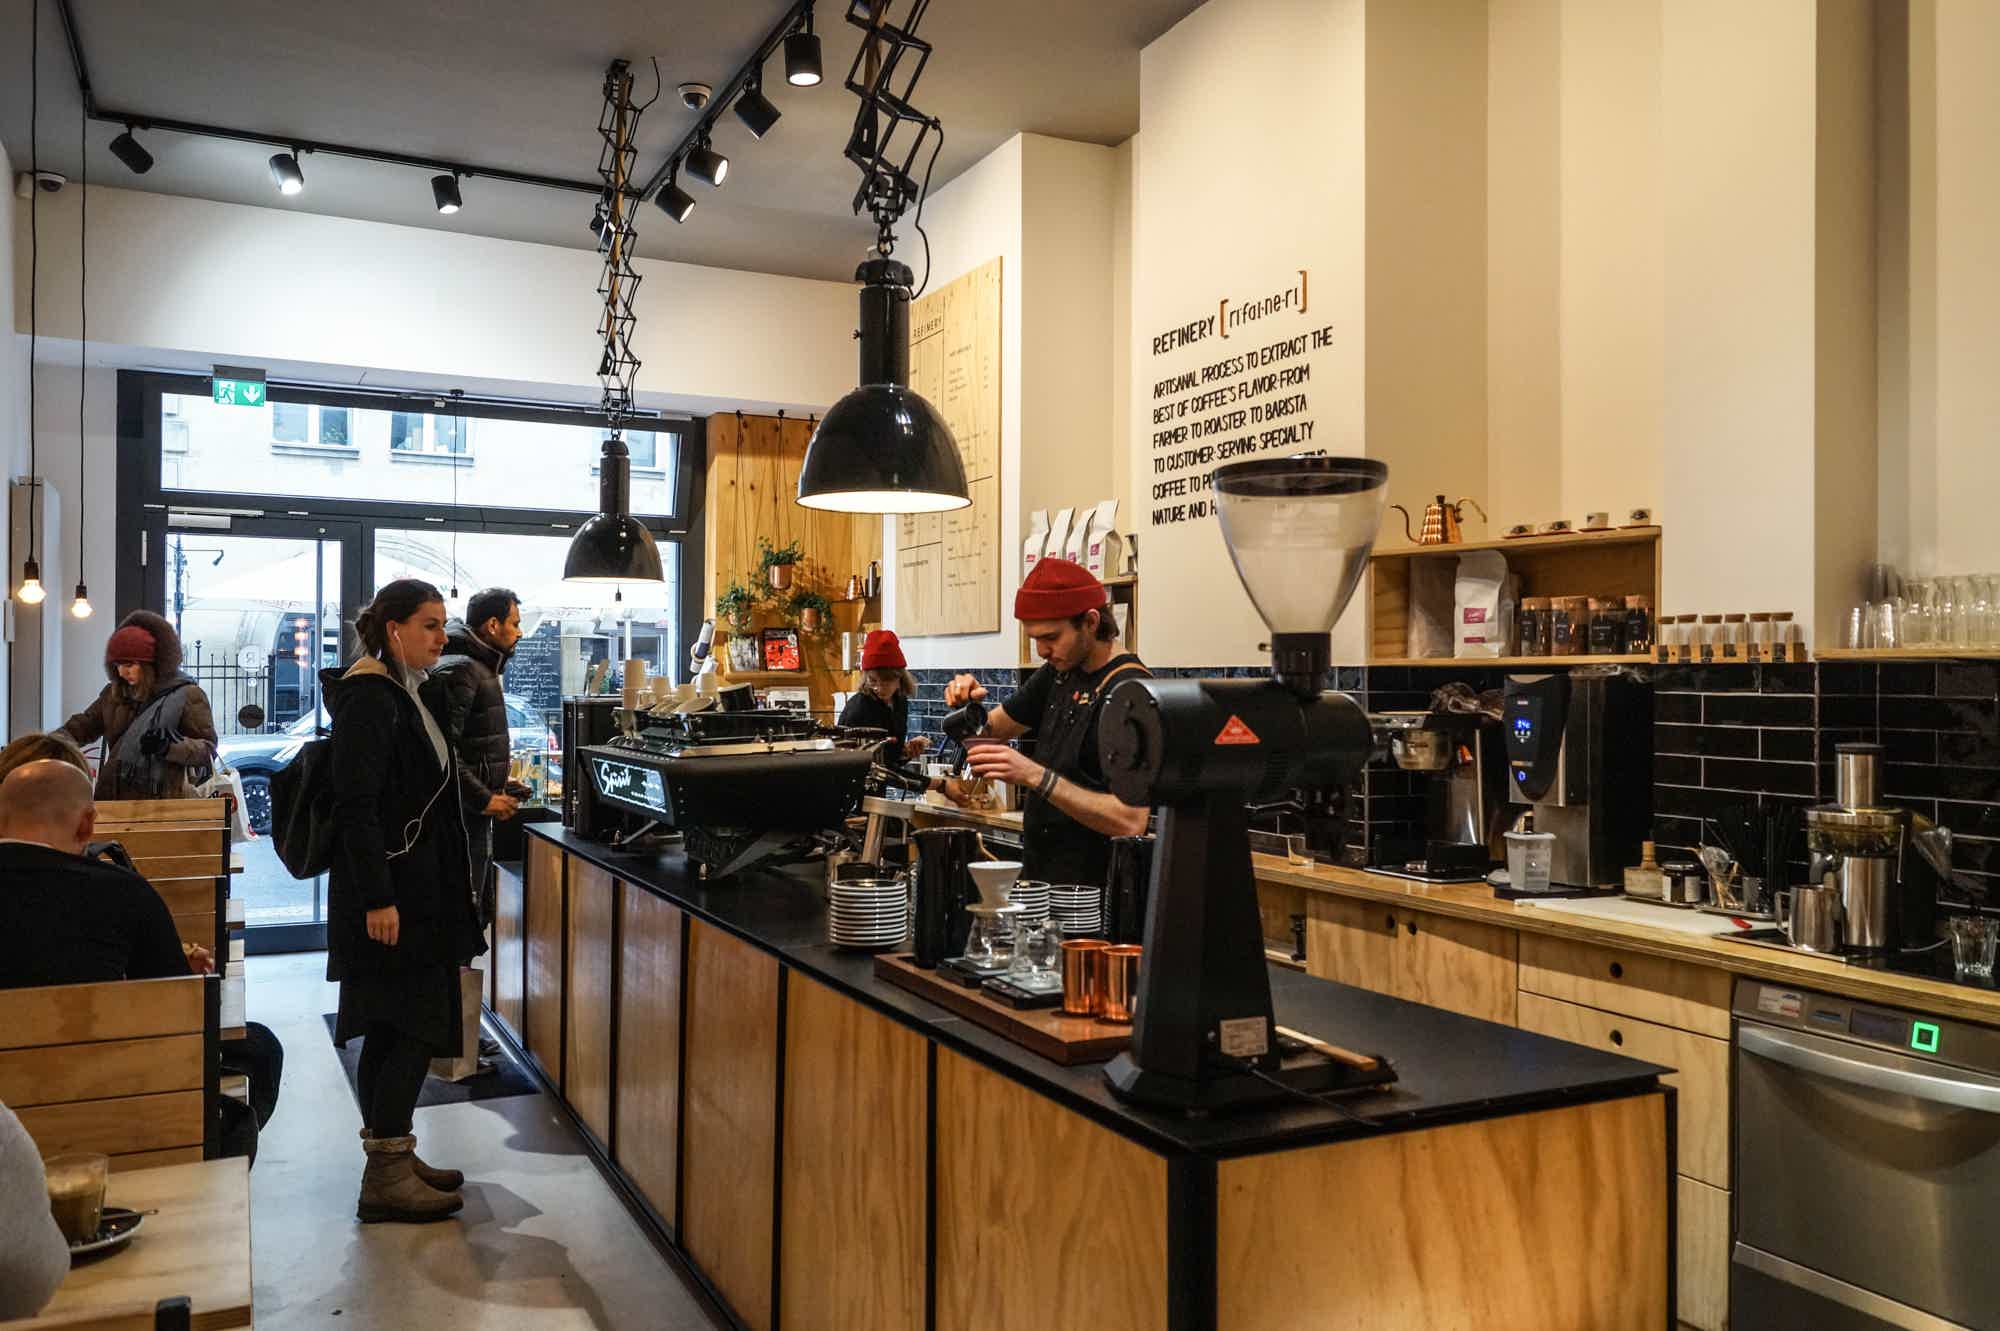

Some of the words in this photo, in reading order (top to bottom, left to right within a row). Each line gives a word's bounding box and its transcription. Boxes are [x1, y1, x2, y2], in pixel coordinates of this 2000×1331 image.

[1152, 315, 1215, 355] REFINERY
[1153, 370, 1199, 399] ARTISANAL
[1201, 356, 1244, 384] PROCESS
[1246, 351, 1258, 370] TO
[1260, 334, 1308, 366] EXTRACT
[1311, 326, 1333, 349] THE
[1153, 403, 1175, 424] BEST
[1177, 399, 1189, 417] OF
[1191, 386, 1237, 413] COFFEE'S
[1153, 426, 1188, 449] FARMER
[1190, 422, 1202, 439] TO
[1204, 410, 1247, 436] ROASTER
[1249, 406, 1263, 424] TO
[1265, 394, 1307, 421] BARISTA
[1153, 458, 1165, 474] TO
[1216, 435, 1256, 460] SERVING
[1259, 421, 1314, 449] SPECIALTY
[1152, 478, 1186, 500] COFFEE
[1189, 476, 1200, 492] TO
[1152, 504, 1186, 526] NATURE
[1188, 501, 1207, 520] AND
